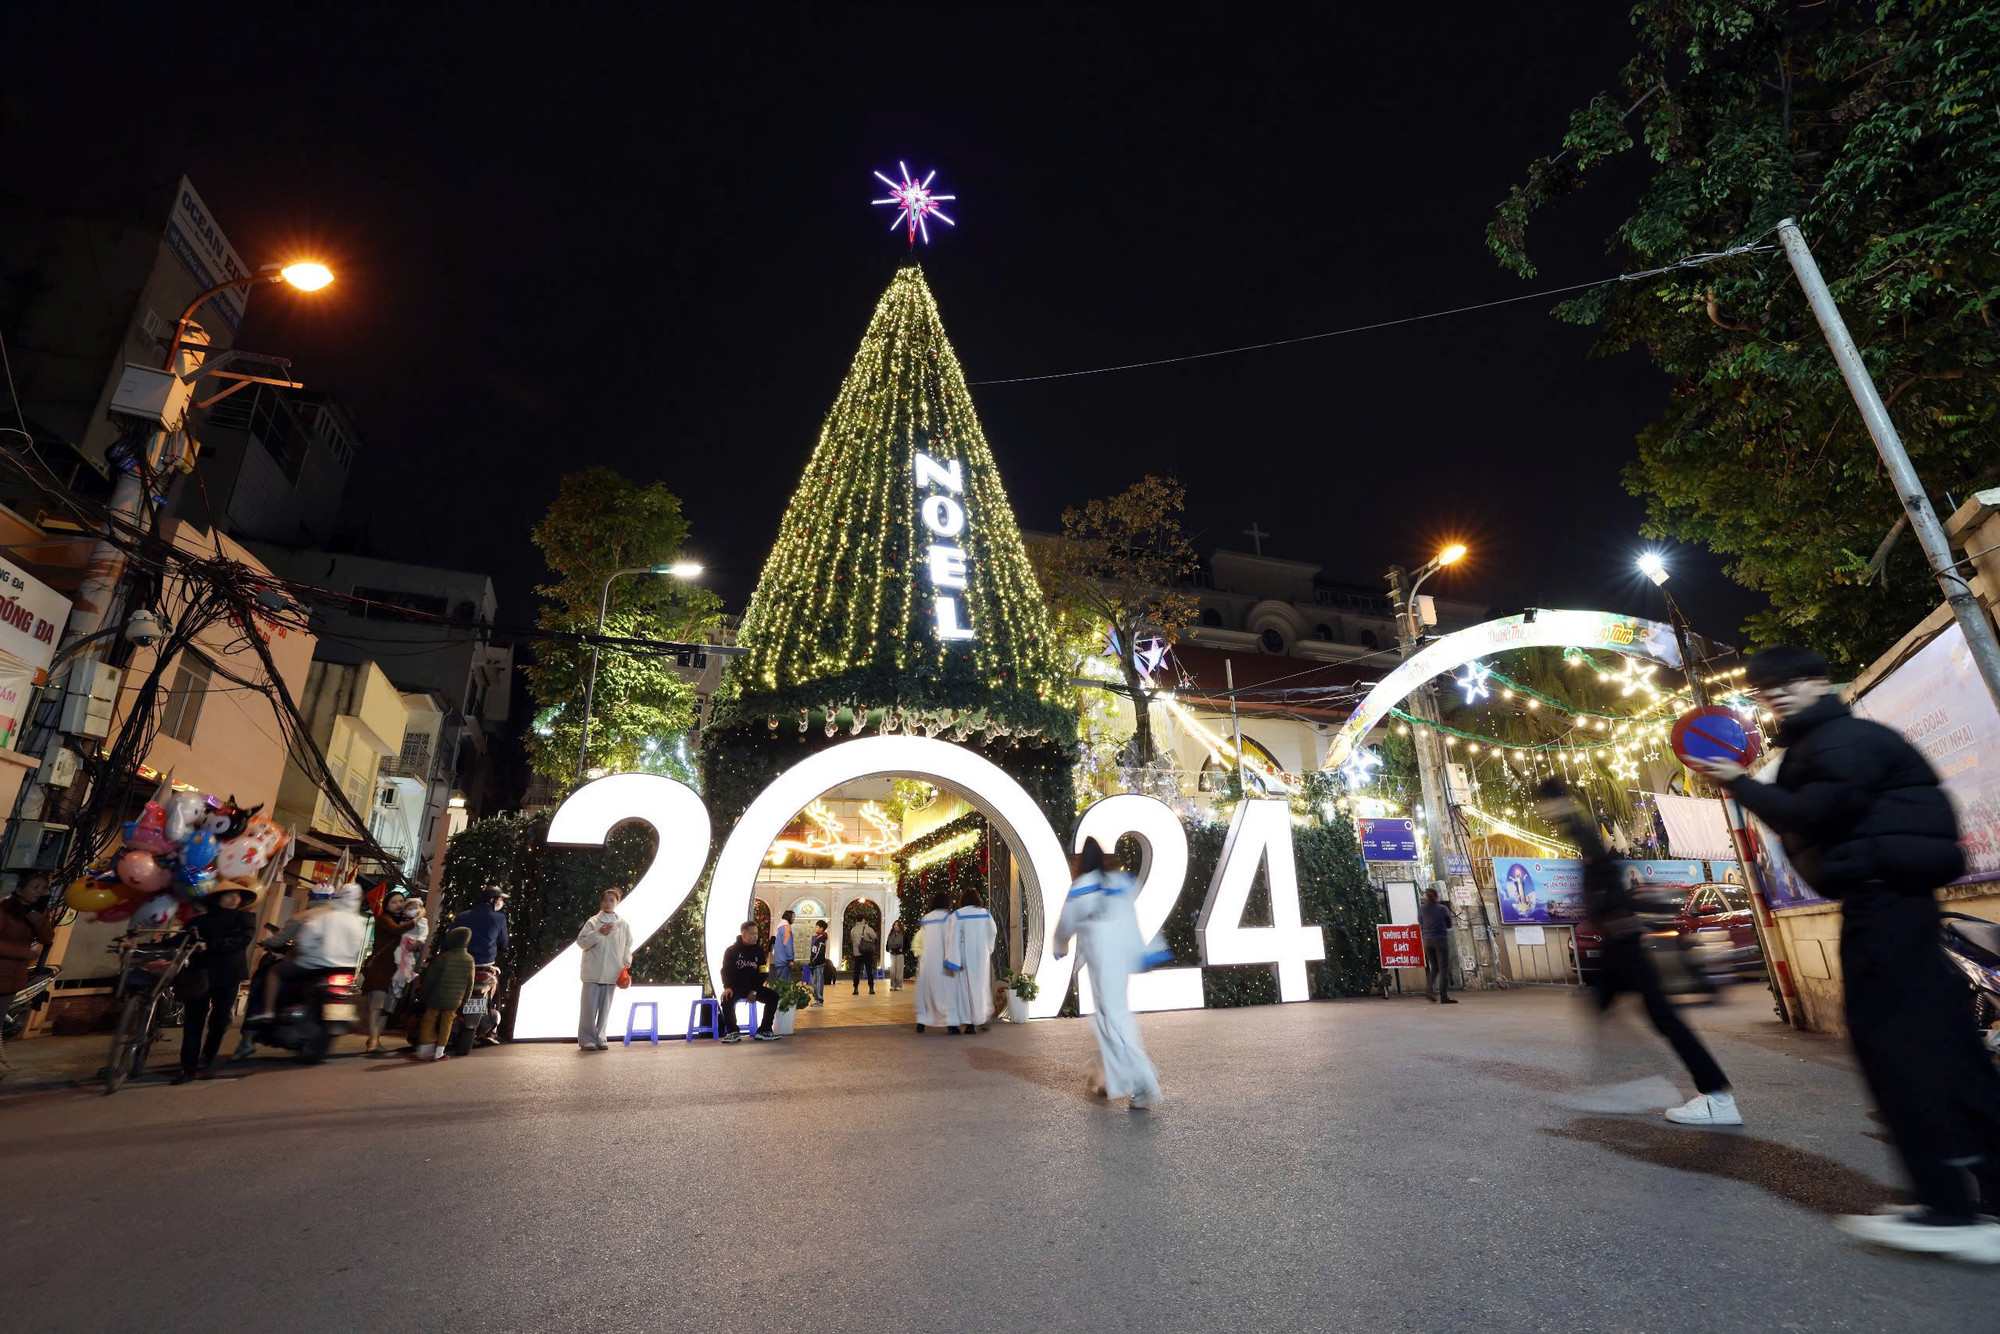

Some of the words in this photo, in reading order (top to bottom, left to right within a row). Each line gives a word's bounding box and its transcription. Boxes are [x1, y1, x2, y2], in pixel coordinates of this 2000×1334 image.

[182, 191, 224, 258] OCEAN
[914, 452, 976, 642] NOEL
[0, 567, 11, 582] NG
[12, 577, 25, 592] ĐA
[34, 619, 55, 645] ĐA
[1609, 622, 1634, 644] Tâm
[1923, 706, 1949, 734] ĐOÀN
[1949, 724, 1975, 752] NHAI
[514, 735, 1328, 1043] 2024
[1382, 930, 1401, 939] KHÔNG
[1410, 930, 1418, 939] XE
